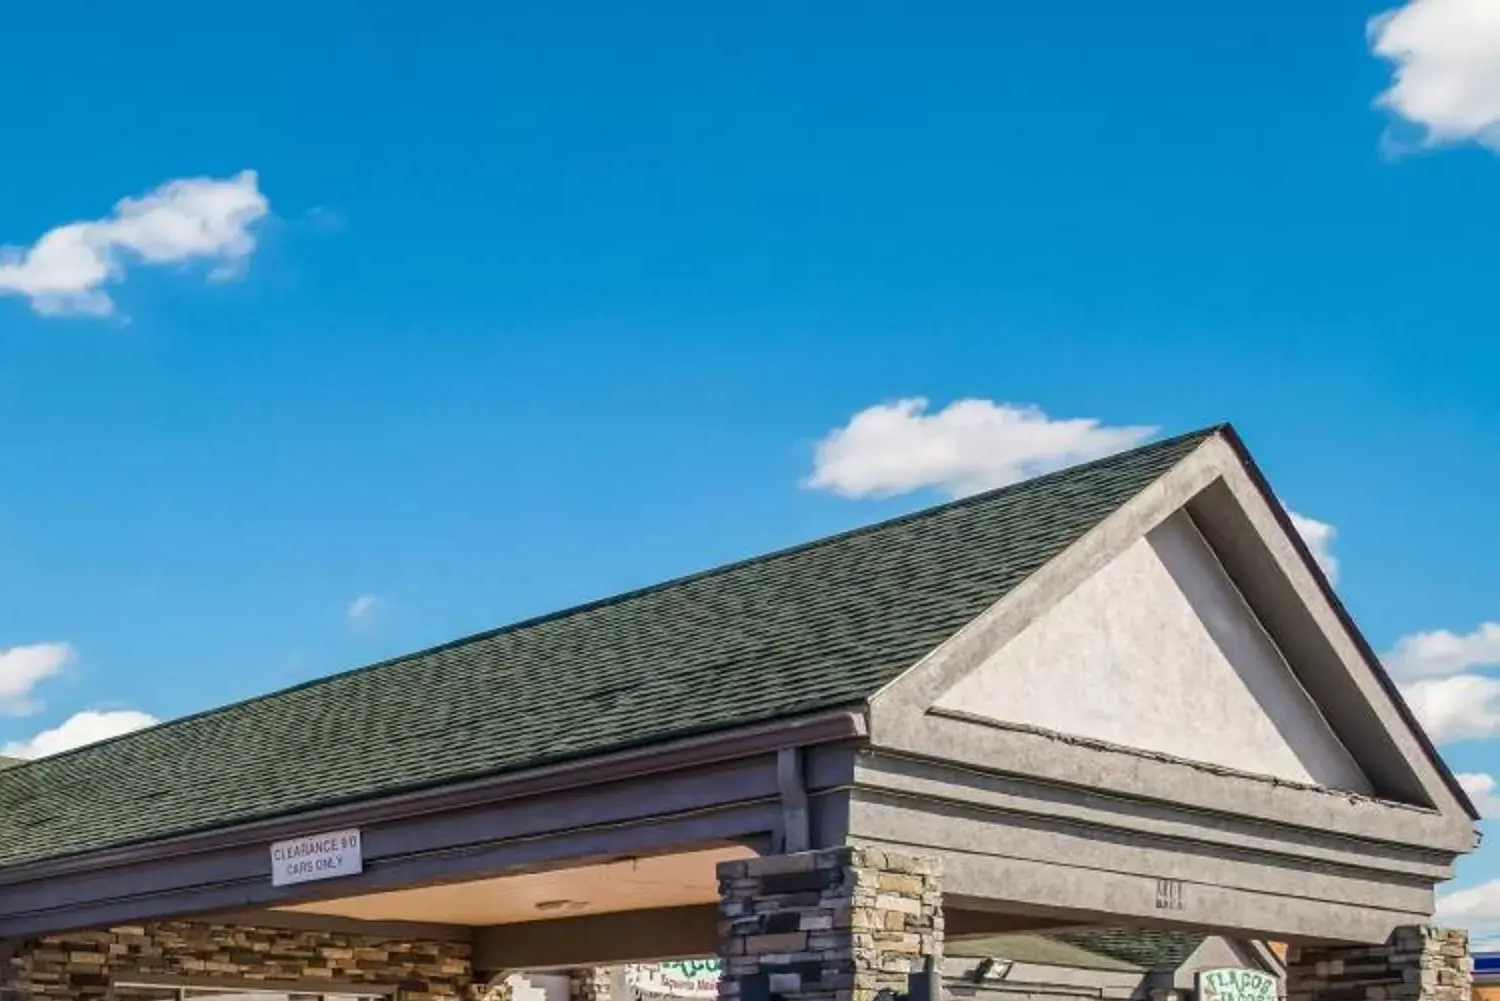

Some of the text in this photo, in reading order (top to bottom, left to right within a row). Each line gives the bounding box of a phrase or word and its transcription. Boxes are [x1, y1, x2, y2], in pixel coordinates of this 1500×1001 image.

[274, 838, 339, 861] CLEARANCE
[287, 855, 343, 876] CARS ONLY
